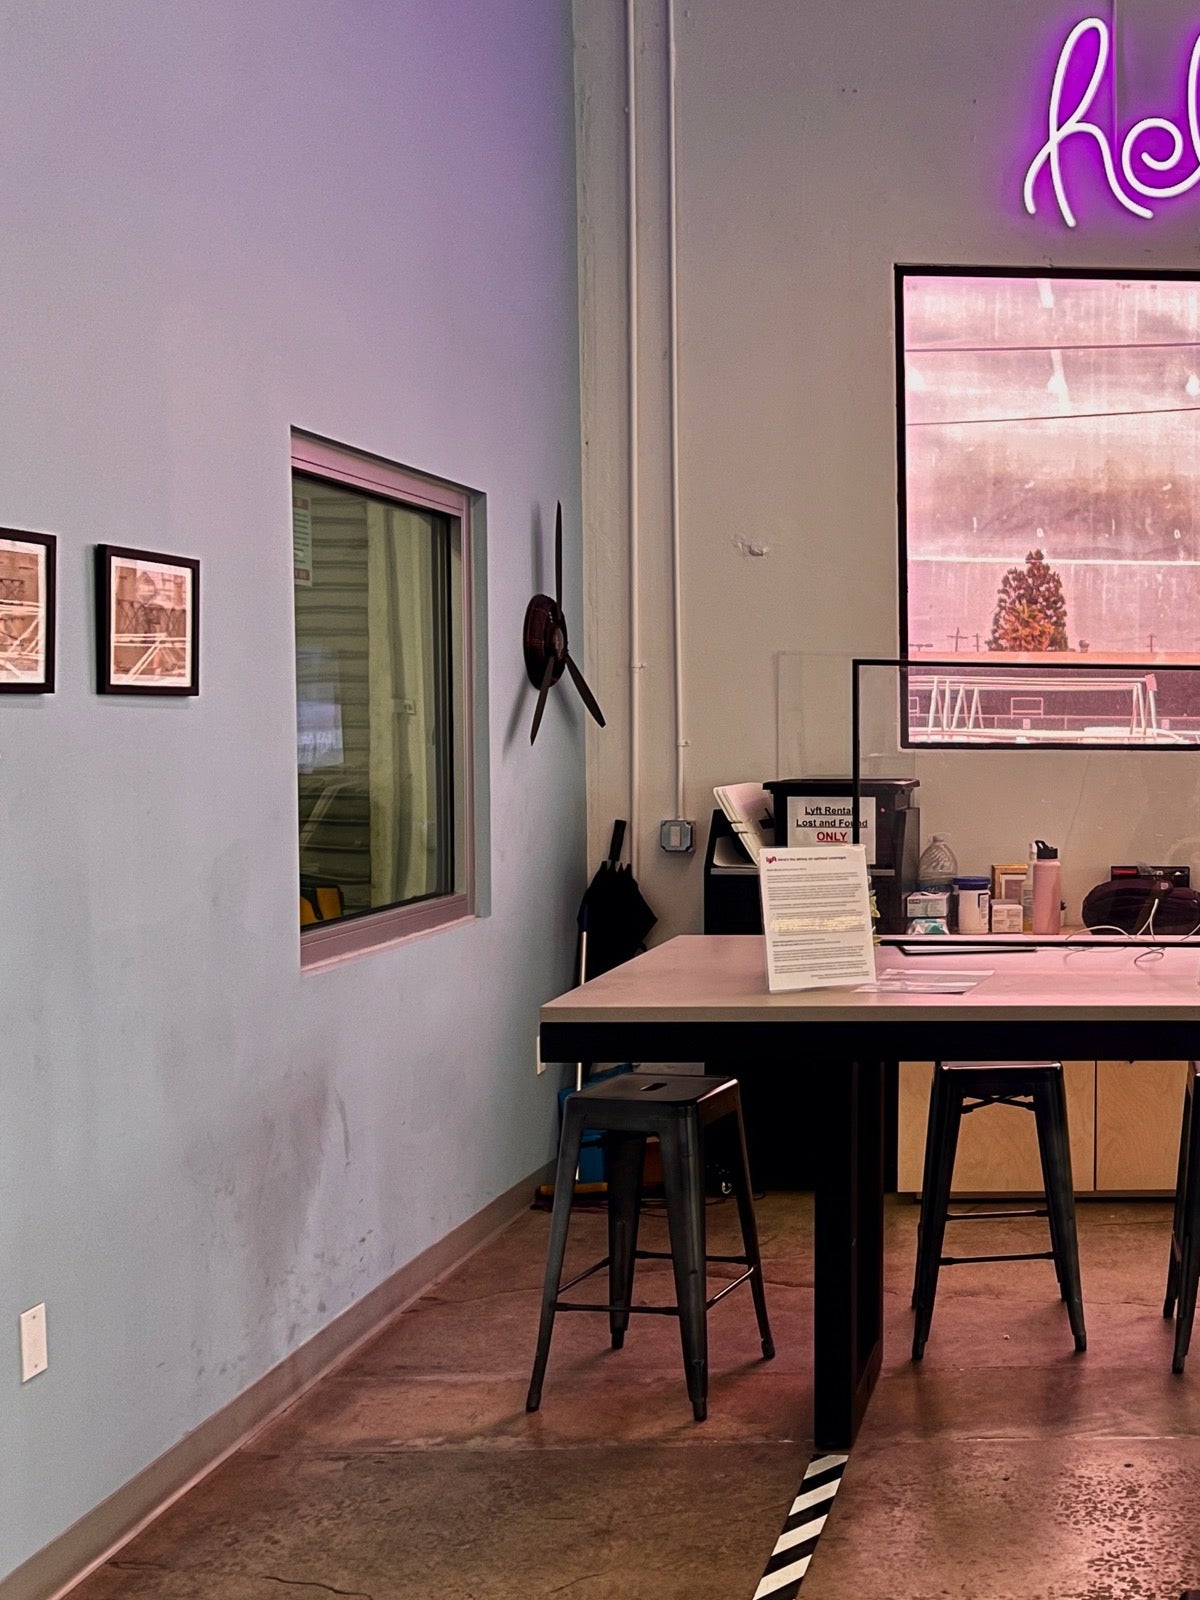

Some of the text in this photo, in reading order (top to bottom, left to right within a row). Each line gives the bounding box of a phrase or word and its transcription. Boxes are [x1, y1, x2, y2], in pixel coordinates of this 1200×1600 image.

[805, 806, 853, 816] Lyft Renta
[796, 819, 868, 827] Lost and Fod
[816, 831, 848, 841] ONLY
